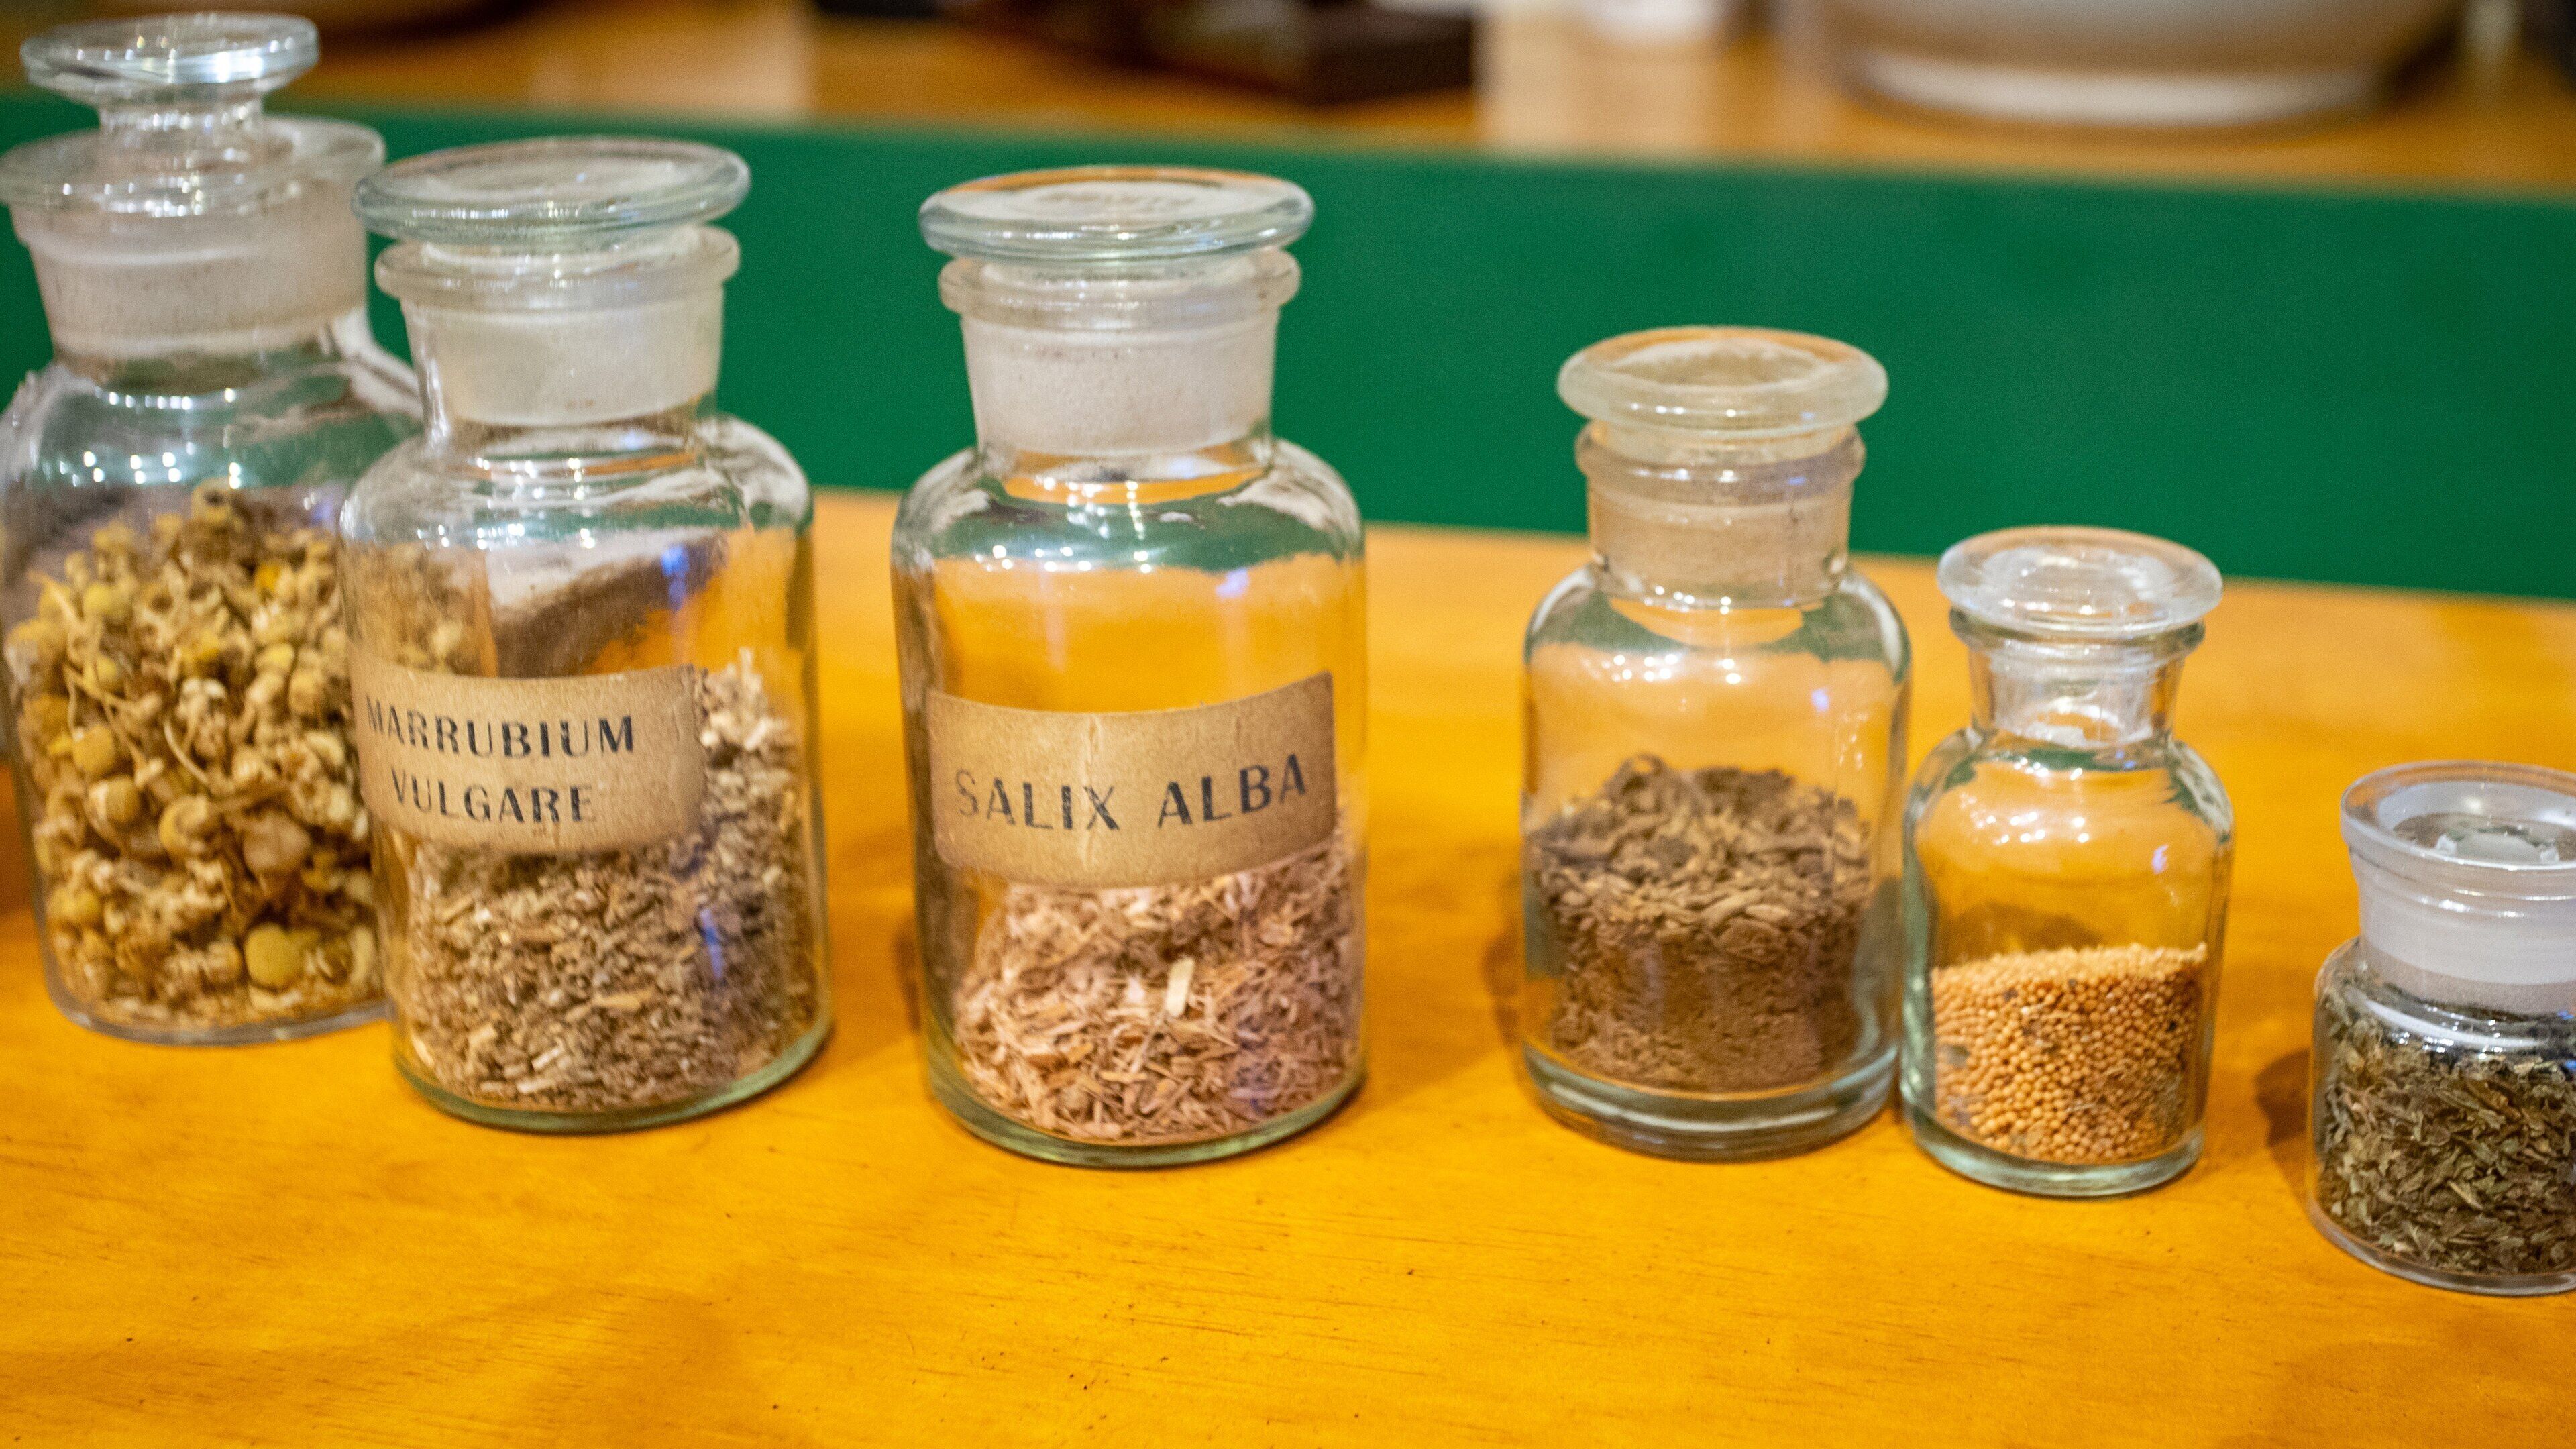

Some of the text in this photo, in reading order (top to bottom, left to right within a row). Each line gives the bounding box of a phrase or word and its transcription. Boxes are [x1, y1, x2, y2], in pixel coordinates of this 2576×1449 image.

[365, 695, 634, 759] MARRUBIUM
[391, 767, 596, 824] VULGARE
[954, 753, 1307, 831] SALIX ALBA
